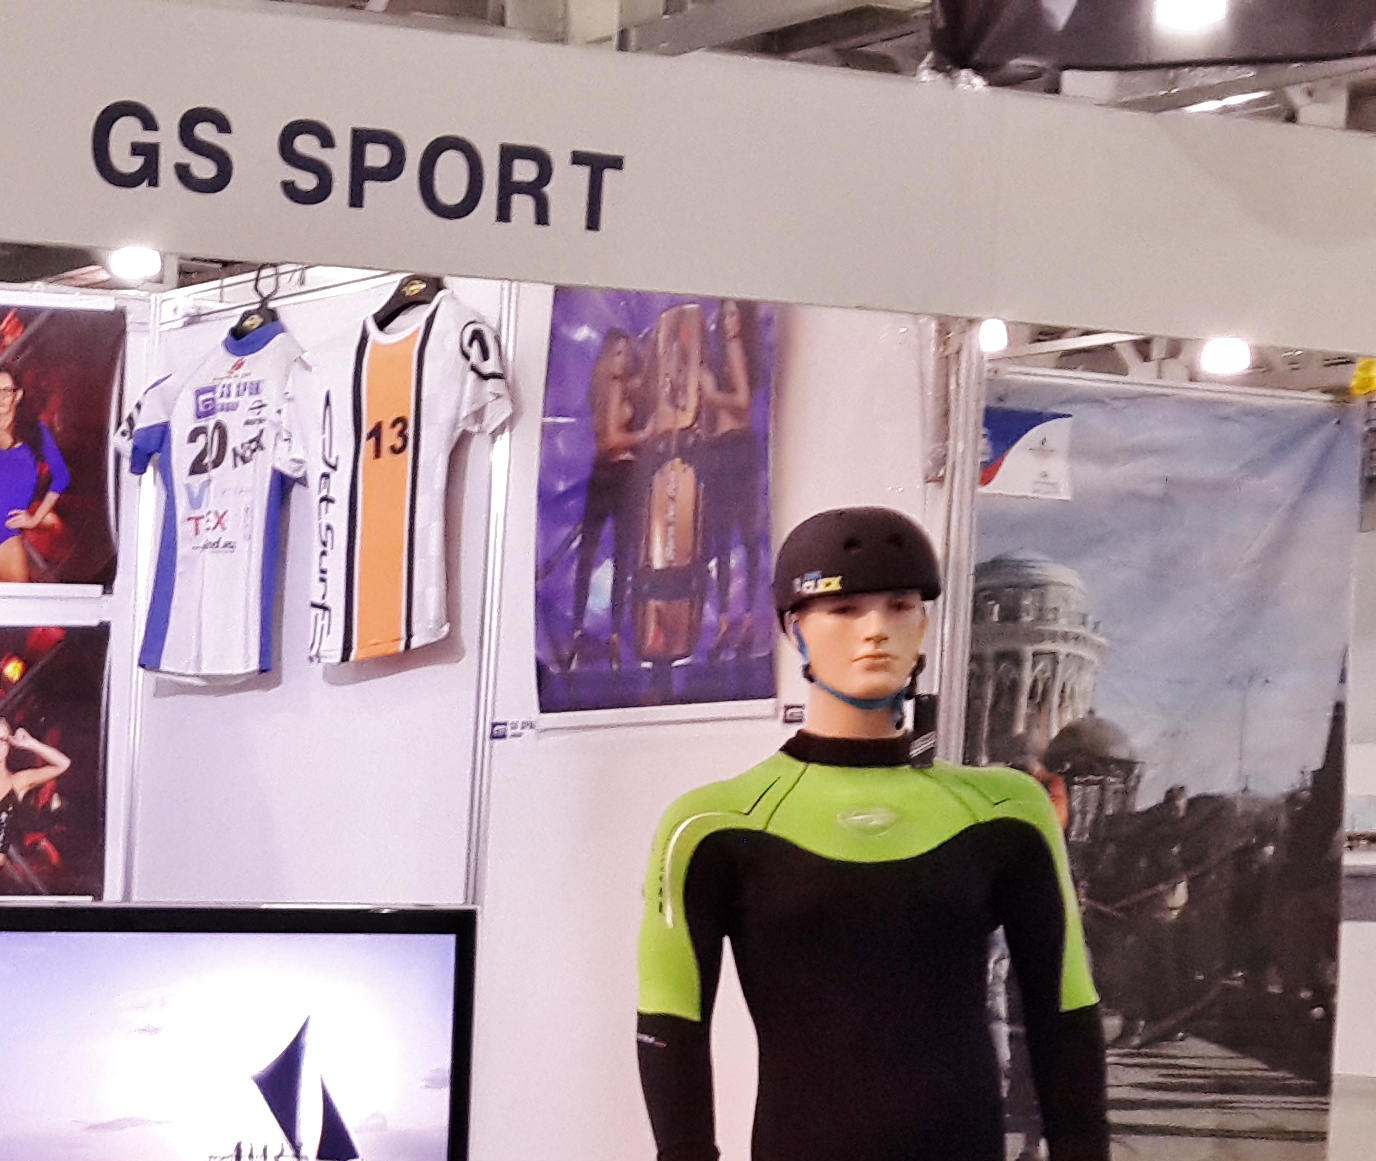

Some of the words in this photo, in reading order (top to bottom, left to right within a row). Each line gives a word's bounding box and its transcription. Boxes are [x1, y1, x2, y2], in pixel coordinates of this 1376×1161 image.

[90, 99, 235, 196] GS
[276, 118, 626, 233] SPORT
[187, 420, 228, 477] 20
[365, 415, 409, 461] 13
